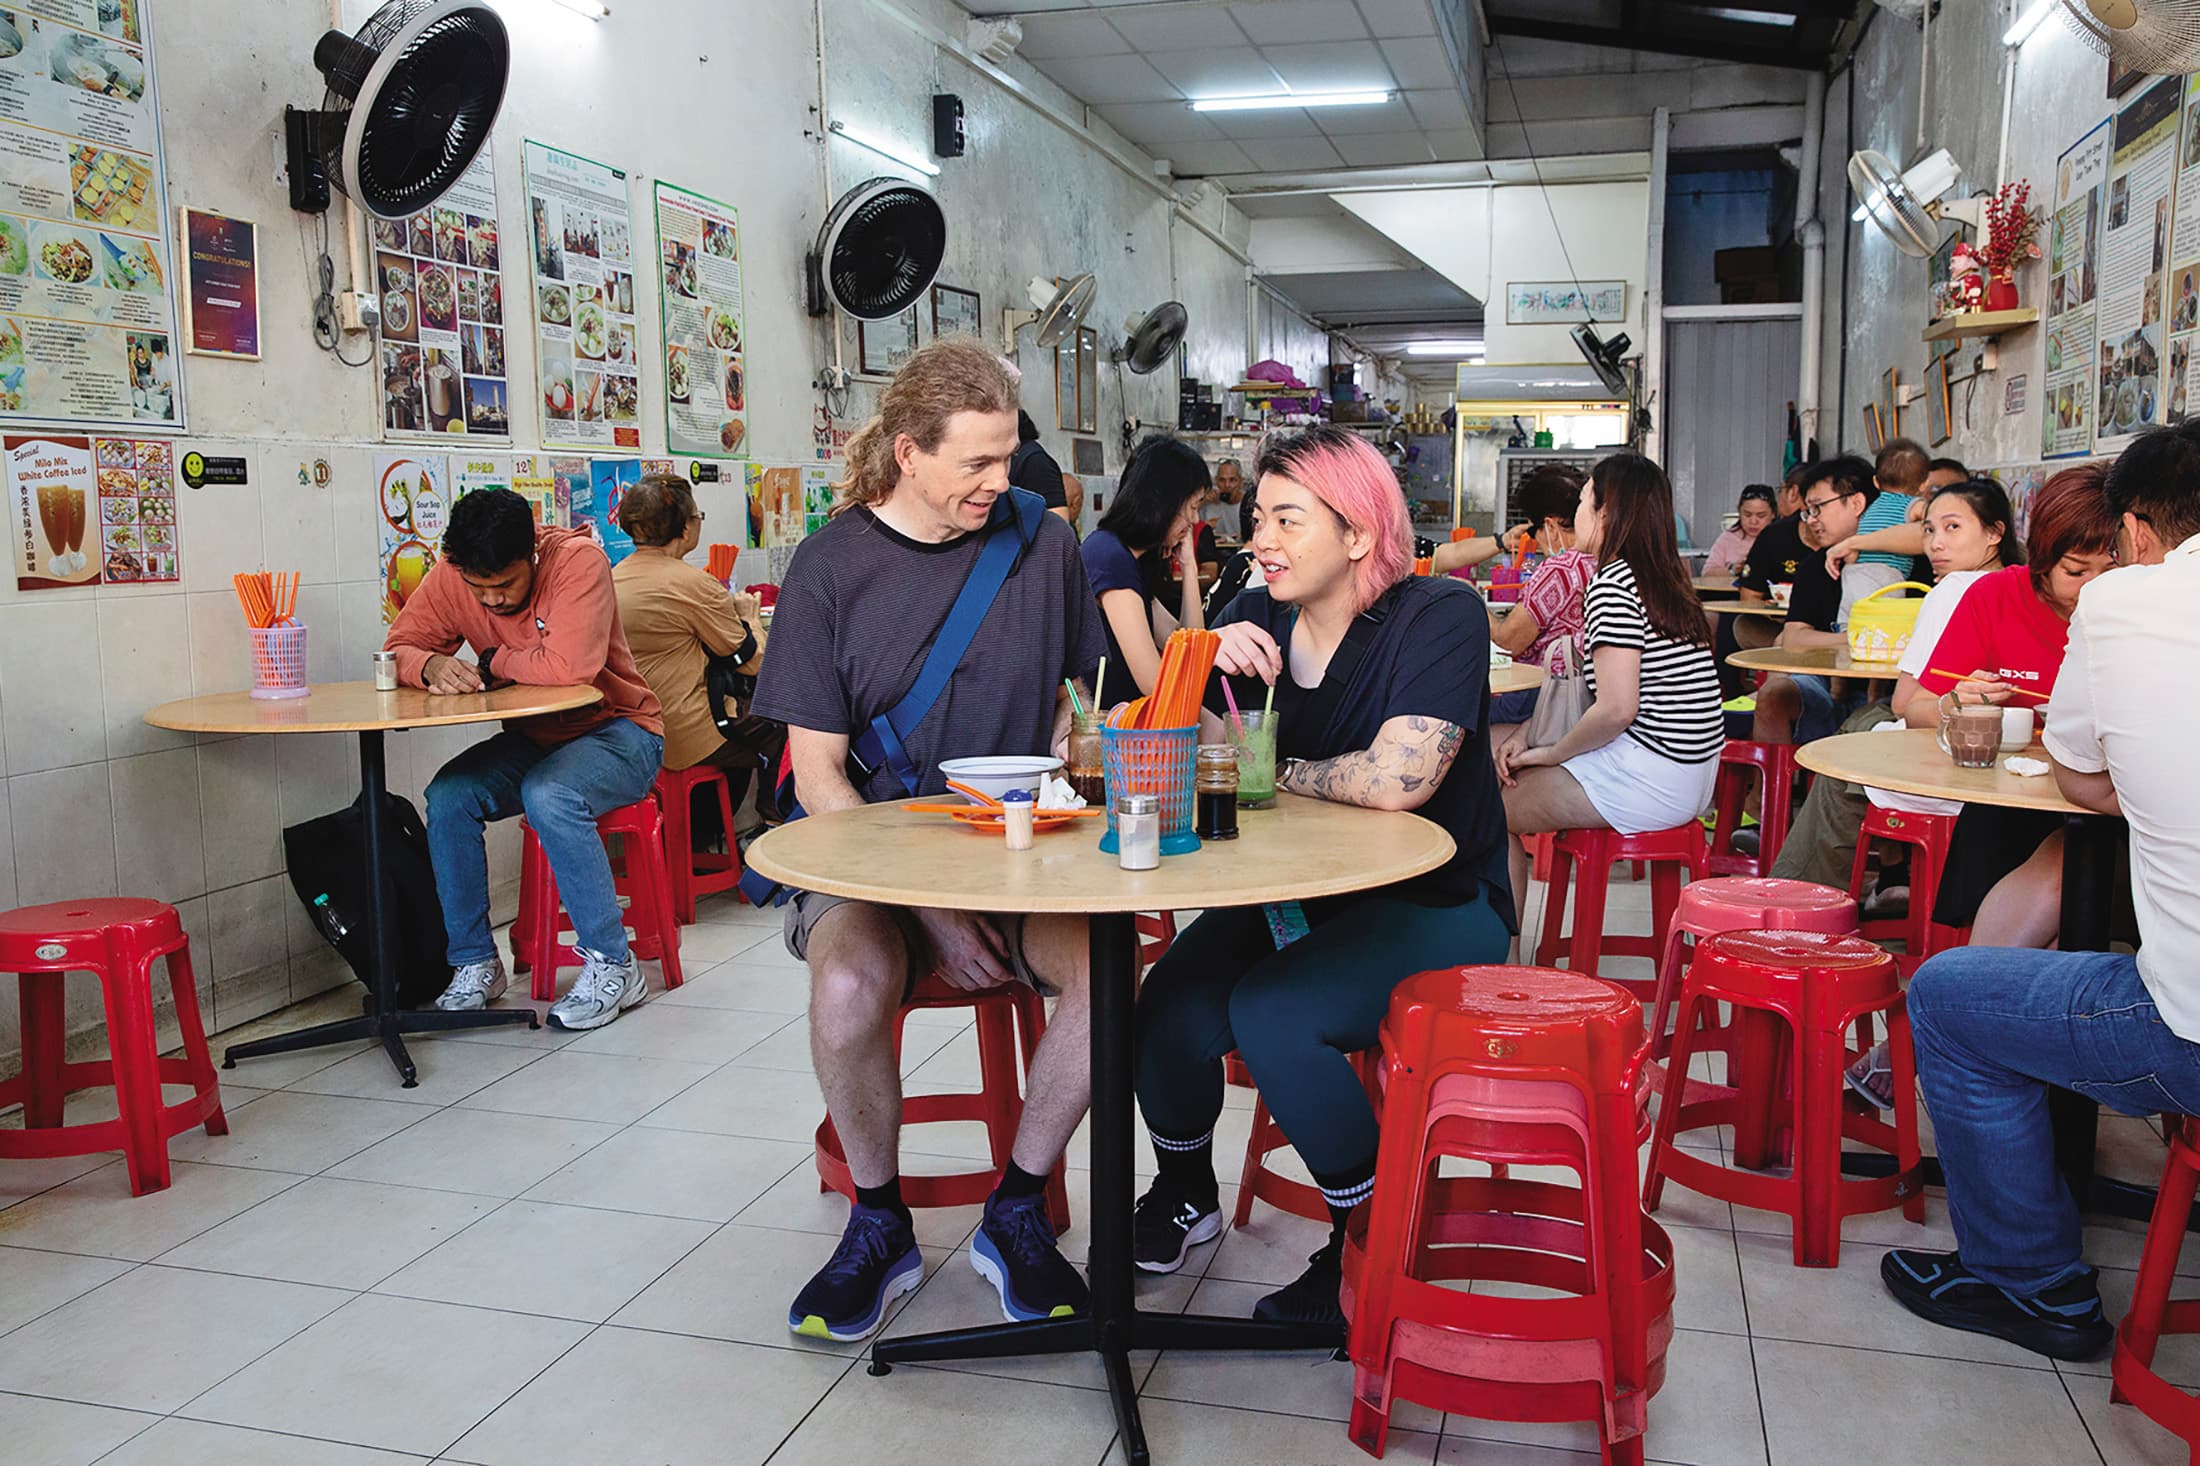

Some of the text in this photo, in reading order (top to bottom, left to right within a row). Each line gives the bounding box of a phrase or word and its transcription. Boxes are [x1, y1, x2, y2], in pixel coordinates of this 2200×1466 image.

[192, 251, 251, 270] CONGRATULATIONS!
[14, 445, 39, 462] Special
[35, 456, 68, 468] Milo Mix
[516, 460, 528, 474] 12
[18, 465, 87, 481] White Coffee Iced
[1999, 668, 2039, 680] GXS
